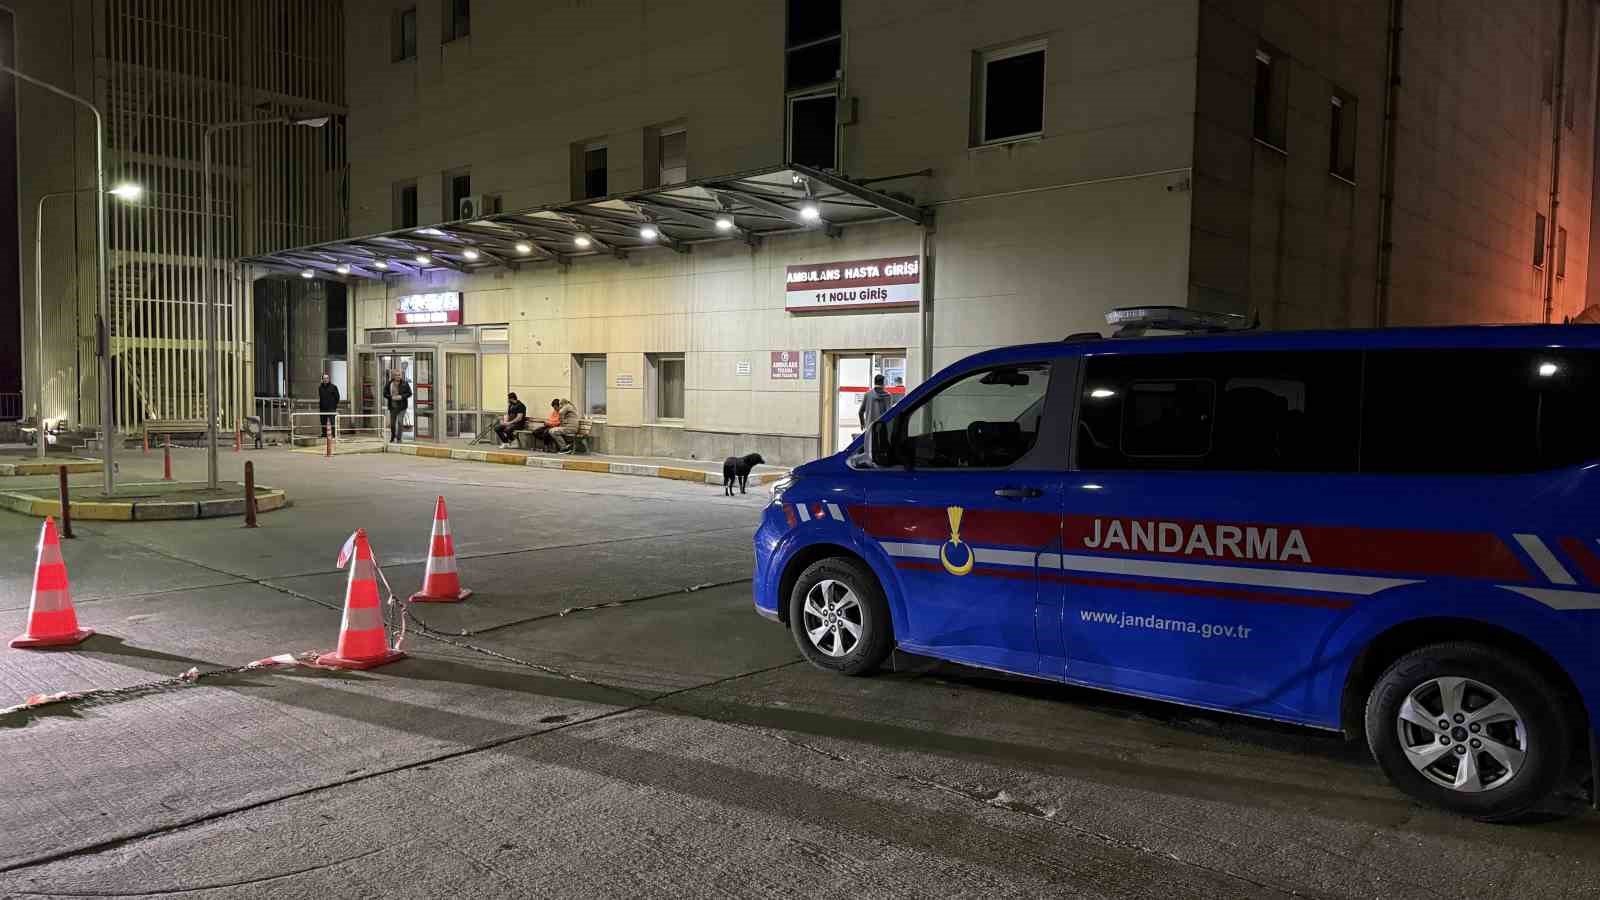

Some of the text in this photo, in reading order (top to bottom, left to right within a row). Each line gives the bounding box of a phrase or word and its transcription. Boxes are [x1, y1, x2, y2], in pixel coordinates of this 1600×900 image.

[787, 260, 919, 283] AMBULANS HASTA GİRİŞİ
[815, 287, 888, 303] 11 NOLU GİRİŞ
[1083, 518, 1312, 563] JANDARMA
[1080, 609, 1252, 639] www.jandarma.gov.tr
